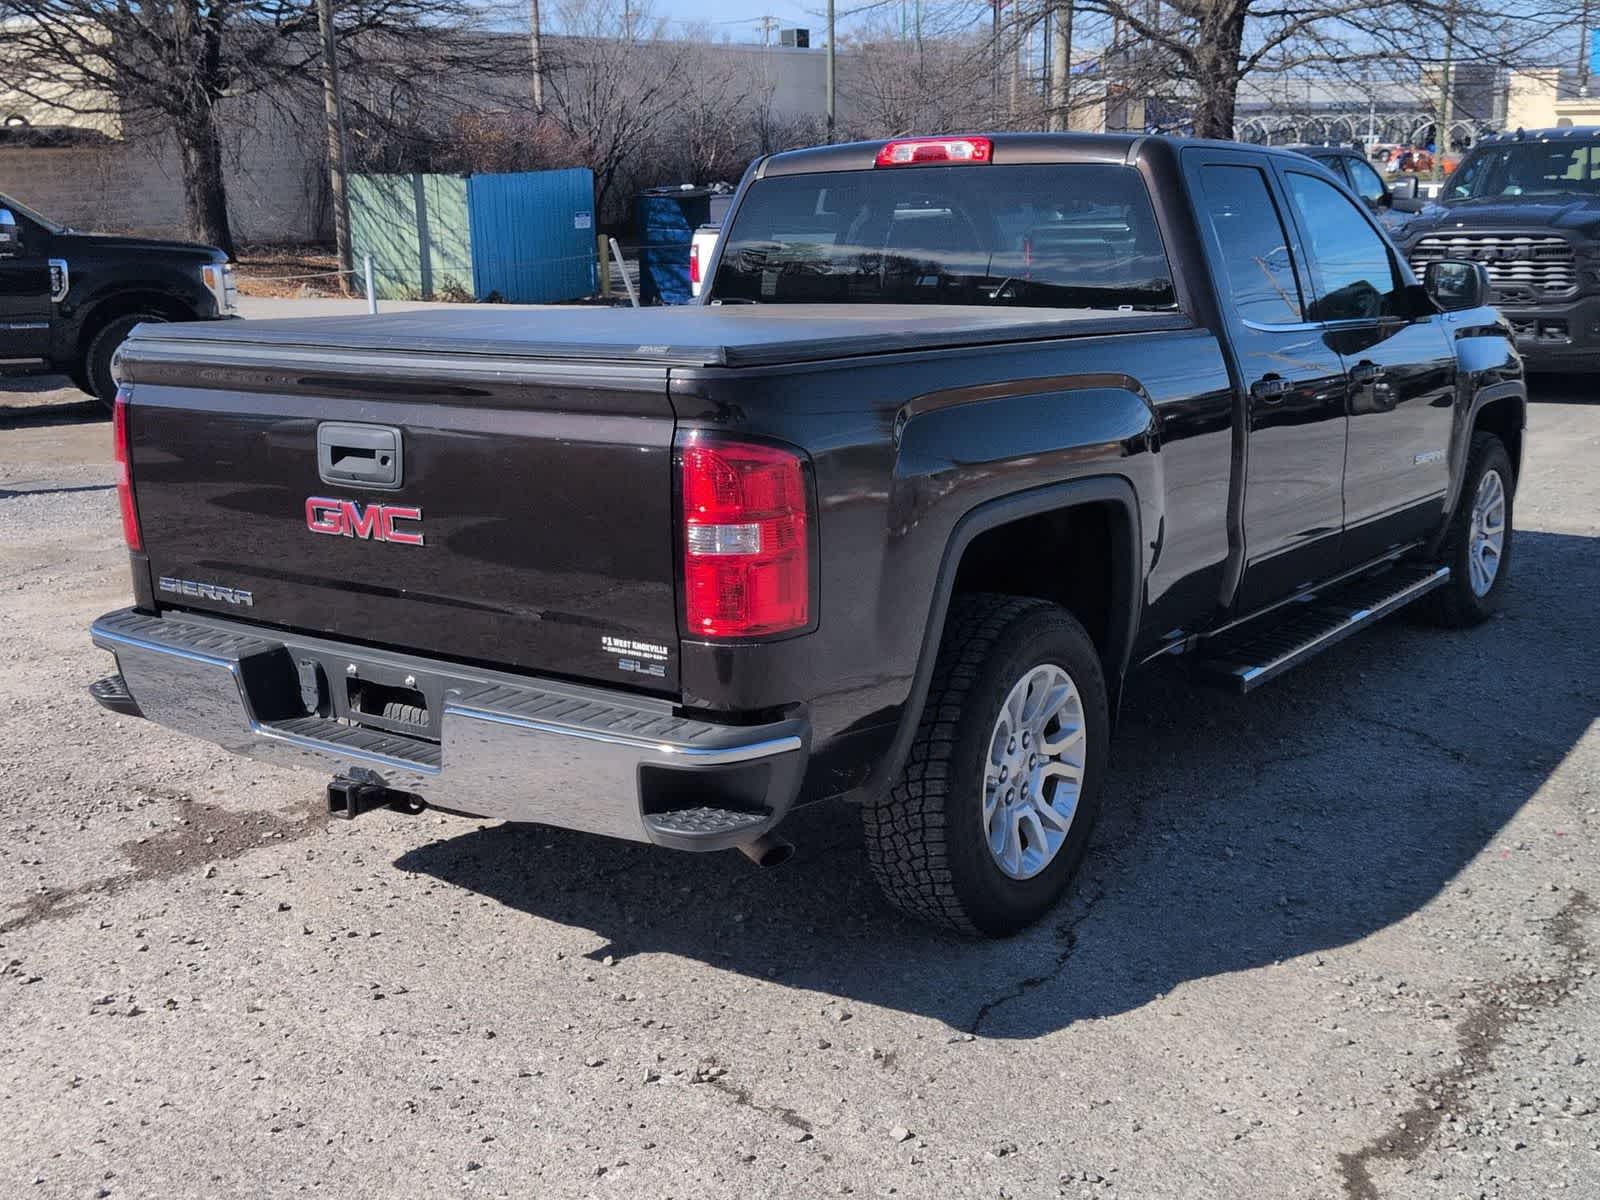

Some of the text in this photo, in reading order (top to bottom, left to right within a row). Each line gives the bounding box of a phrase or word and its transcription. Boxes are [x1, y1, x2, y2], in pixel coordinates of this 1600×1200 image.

[305, 497, 424, 546] GMC
[159, 576, 253, 607] SIERRA
[613, 638, 631, 649] WEST
[632, 641, 668, 655] KNOXVILLE
